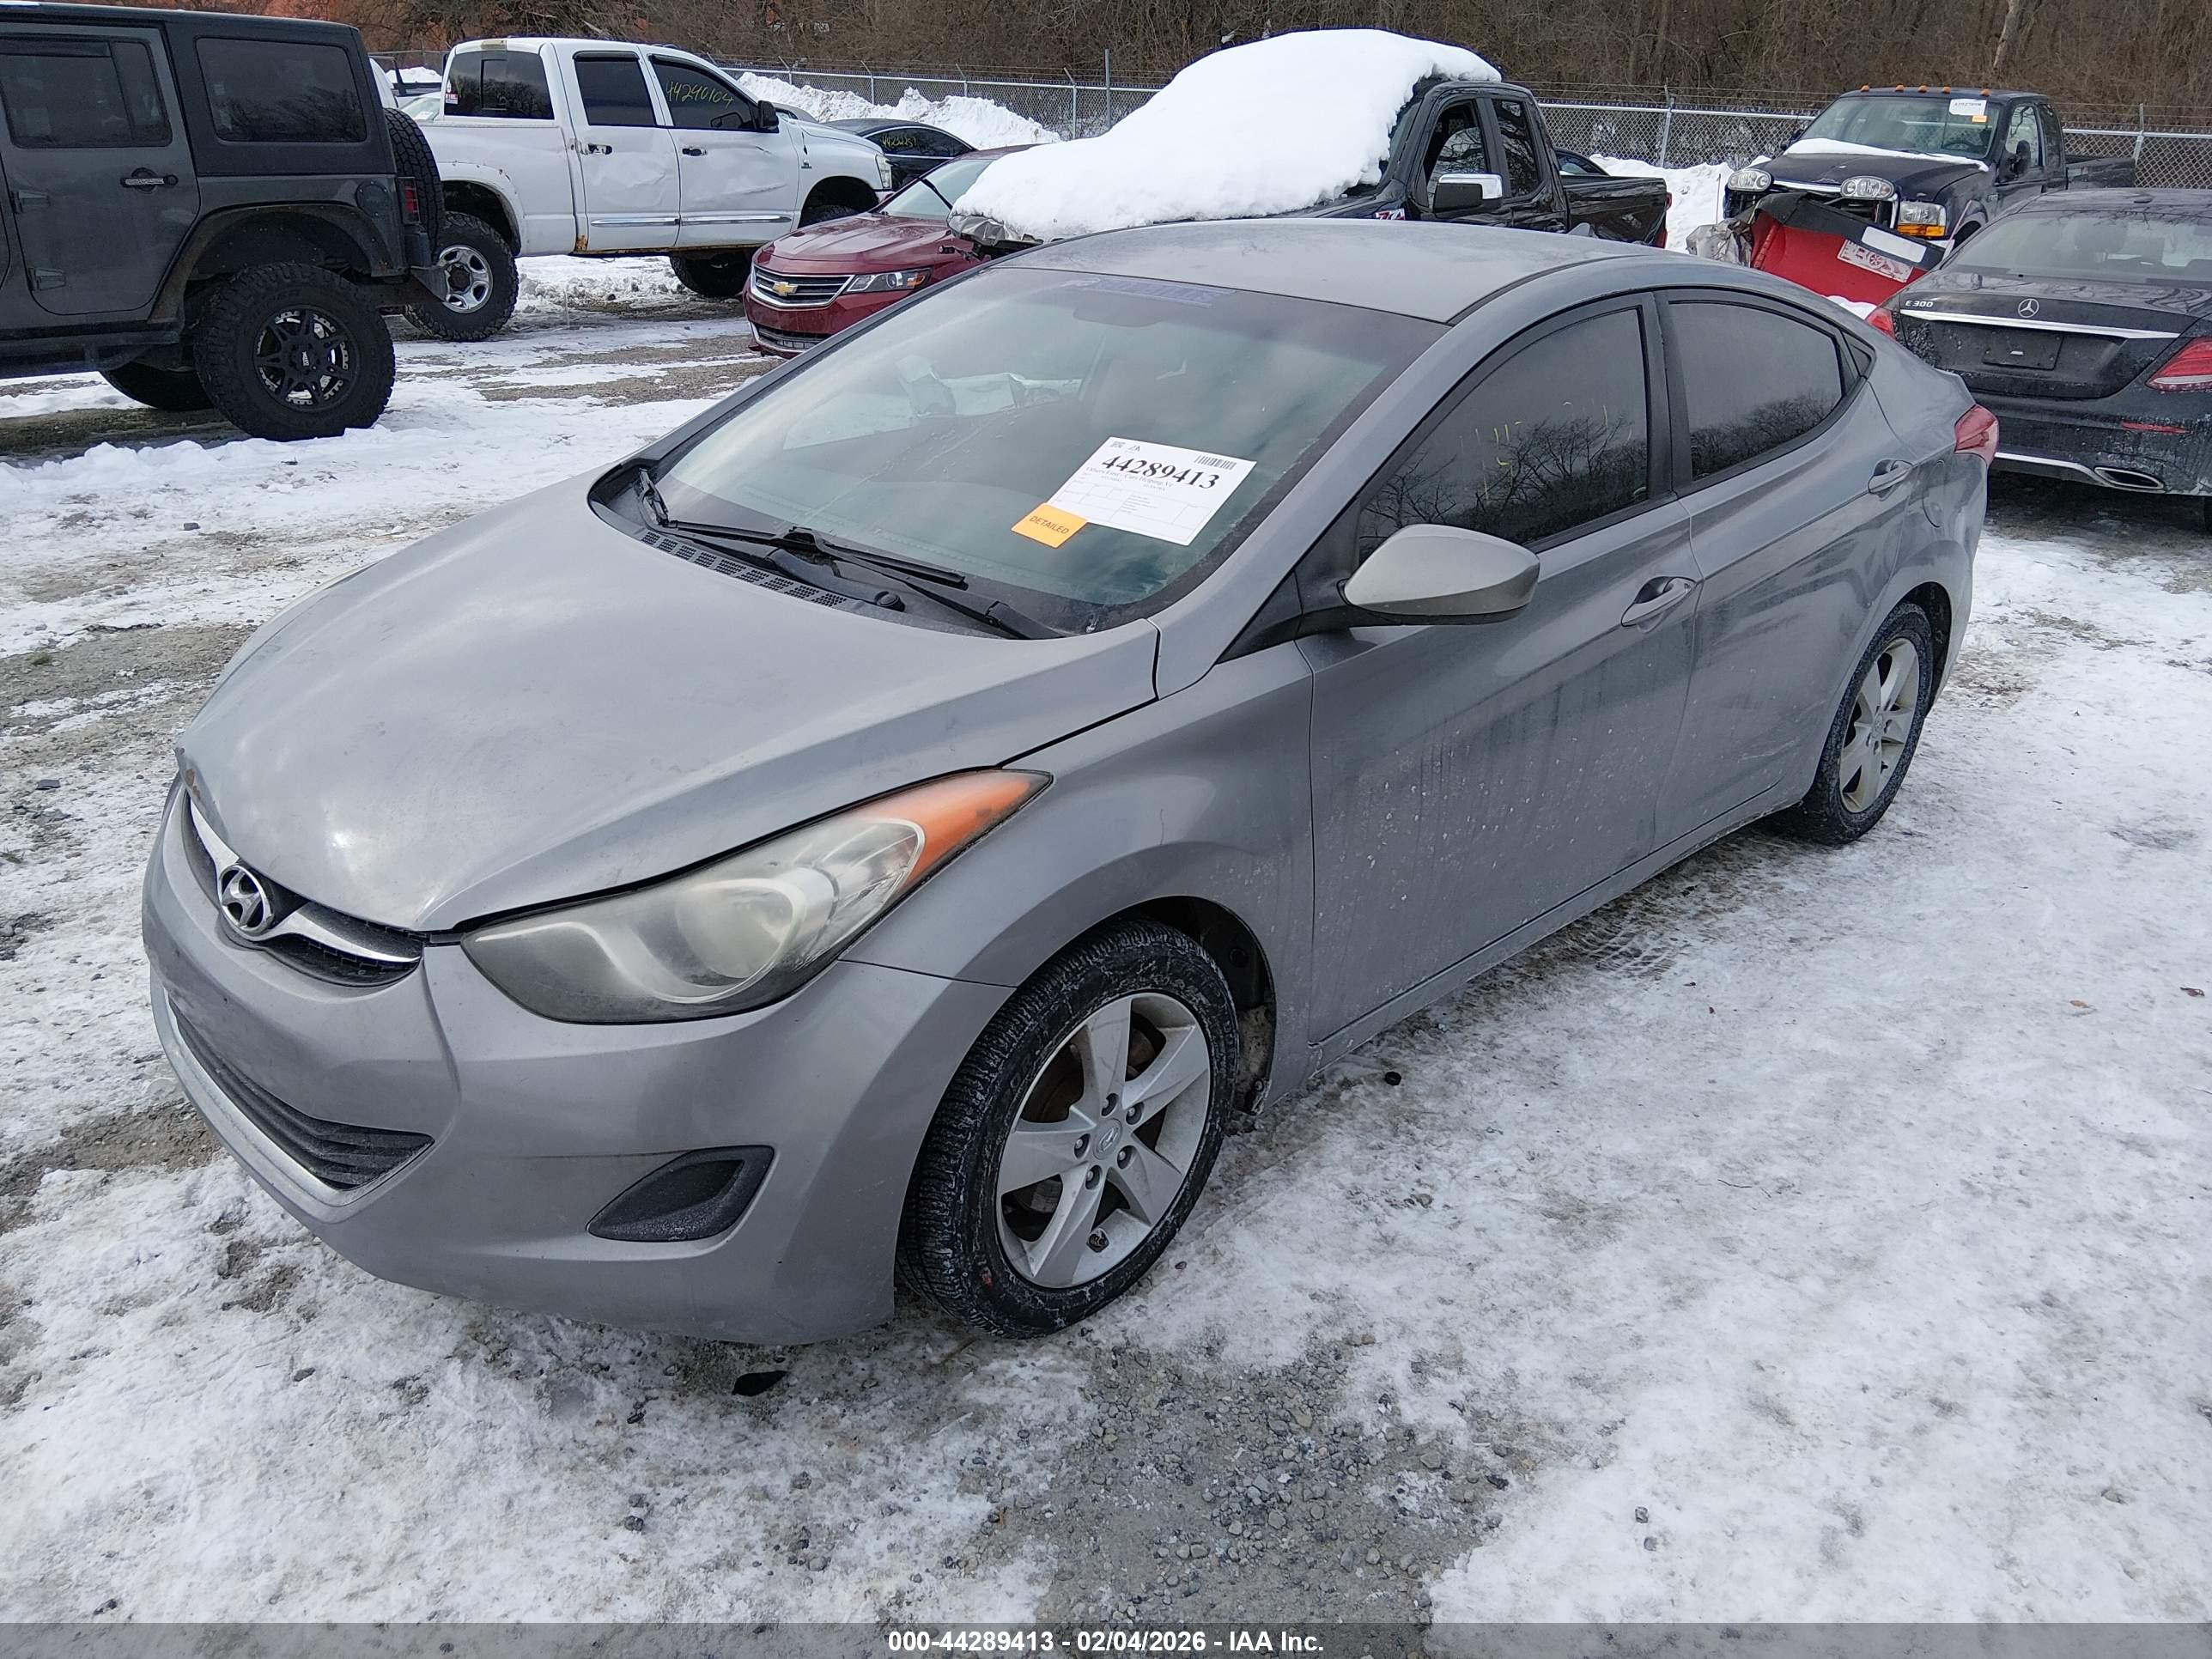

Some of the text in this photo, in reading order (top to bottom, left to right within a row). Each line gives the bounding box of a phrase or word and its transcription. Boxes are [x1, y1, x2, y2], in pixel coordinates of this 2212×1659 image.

[665, 81, 734, 109] 44240104
[1102, 455, 1220, 489] 44289413
[1029, 515, 1070, 534] DETAILED
